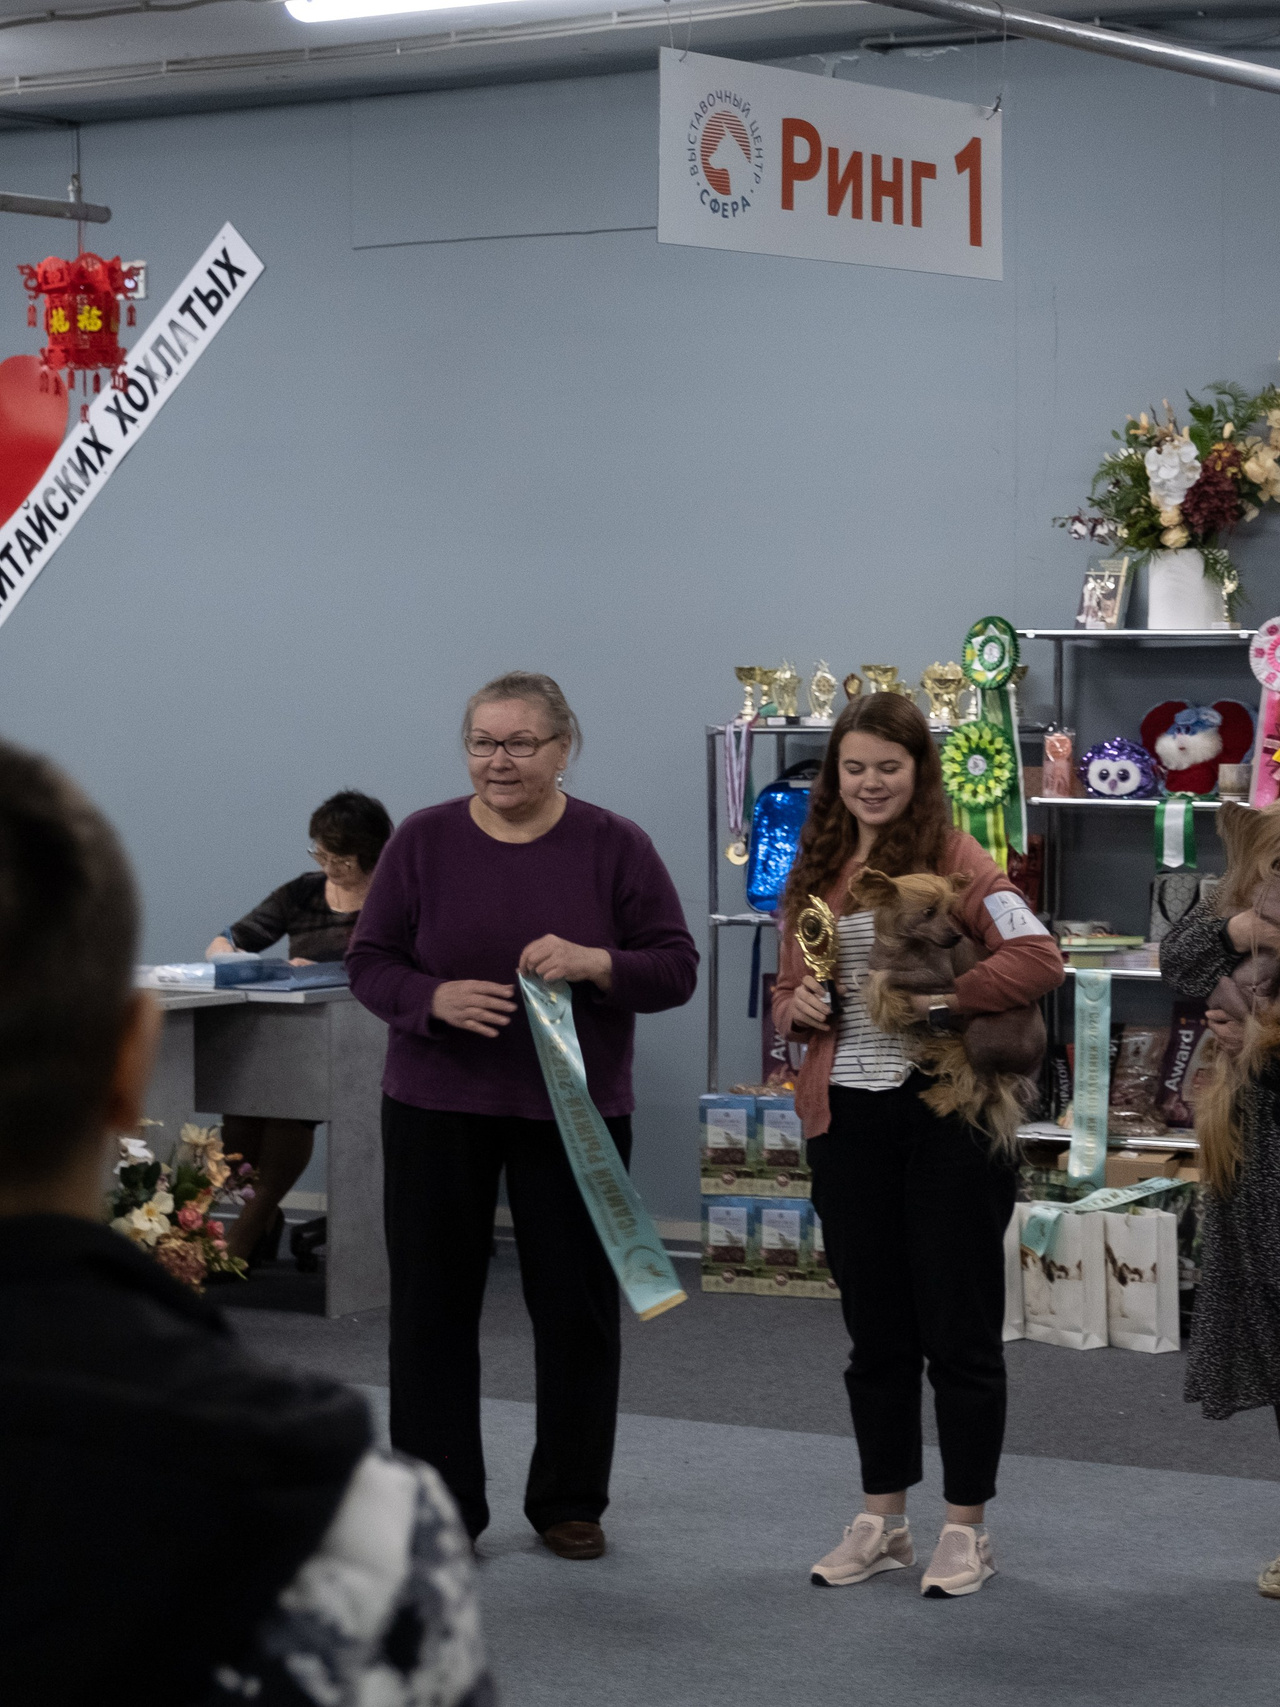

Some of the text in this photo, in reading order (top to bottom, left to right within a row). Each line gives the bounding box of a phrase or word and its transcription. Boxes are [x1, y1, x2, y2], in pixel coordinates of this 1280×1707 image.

[687, 90, 764, 184] ВЫСТАВОЧНЫЙ ЦЕНТР
[781, 118, 982, 247] Ринг 1
[700, 188, 751, 219] СФЕРА
[0, 248, 247, 609] ИТАЙСКИХ ХОХЛАТЫХ
[1164, 1029, 1194, 1092] Award
